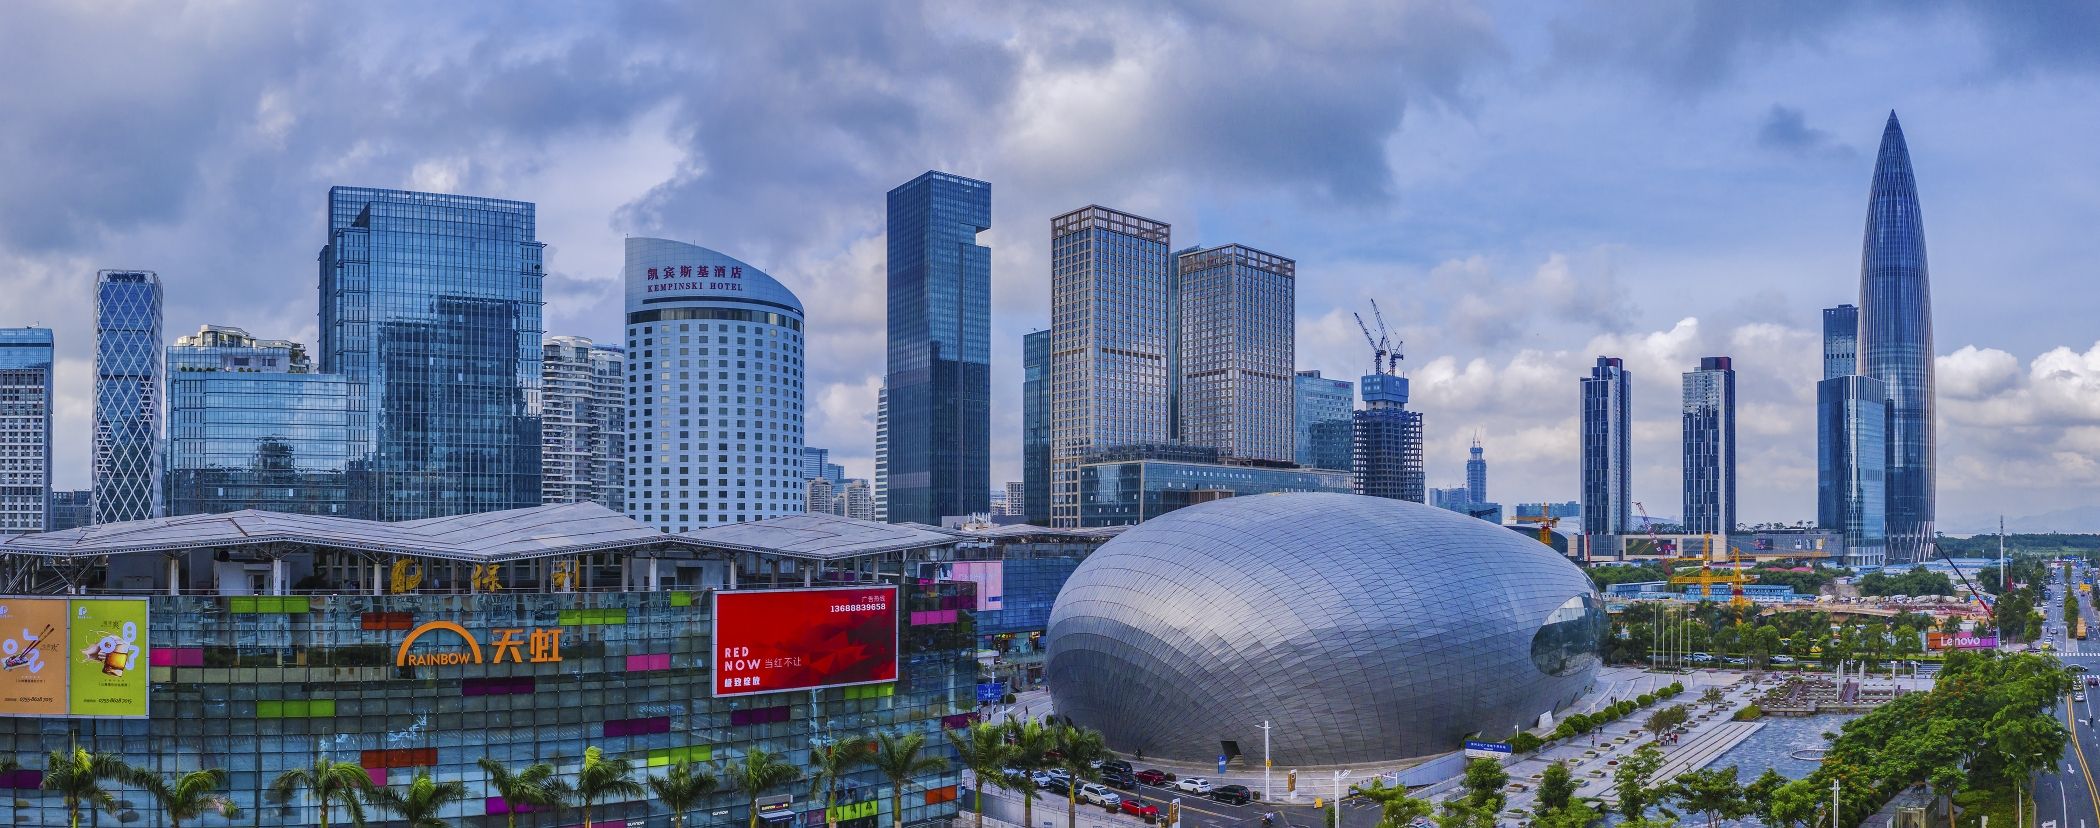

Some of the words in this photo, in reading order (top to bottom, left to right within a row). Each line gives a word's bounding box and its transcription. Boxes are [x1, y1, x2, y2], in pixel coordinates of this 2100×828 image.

[647, 265, 742, 280] 凯宾斯基酒店
[648, 282, 703, 292] KEMPINSKI
[710, 282, 743, 292] HOTEL
[491, 628, 563, 664] 天虹
[1941, 637, 1980, 647] Lenovo
[724, 647, 749, 658] RED
[408, 653, 471, 666] RAINBOW
[724, 659, 761, 671] NOW
[765, 657, 801, 669] 当红不让
